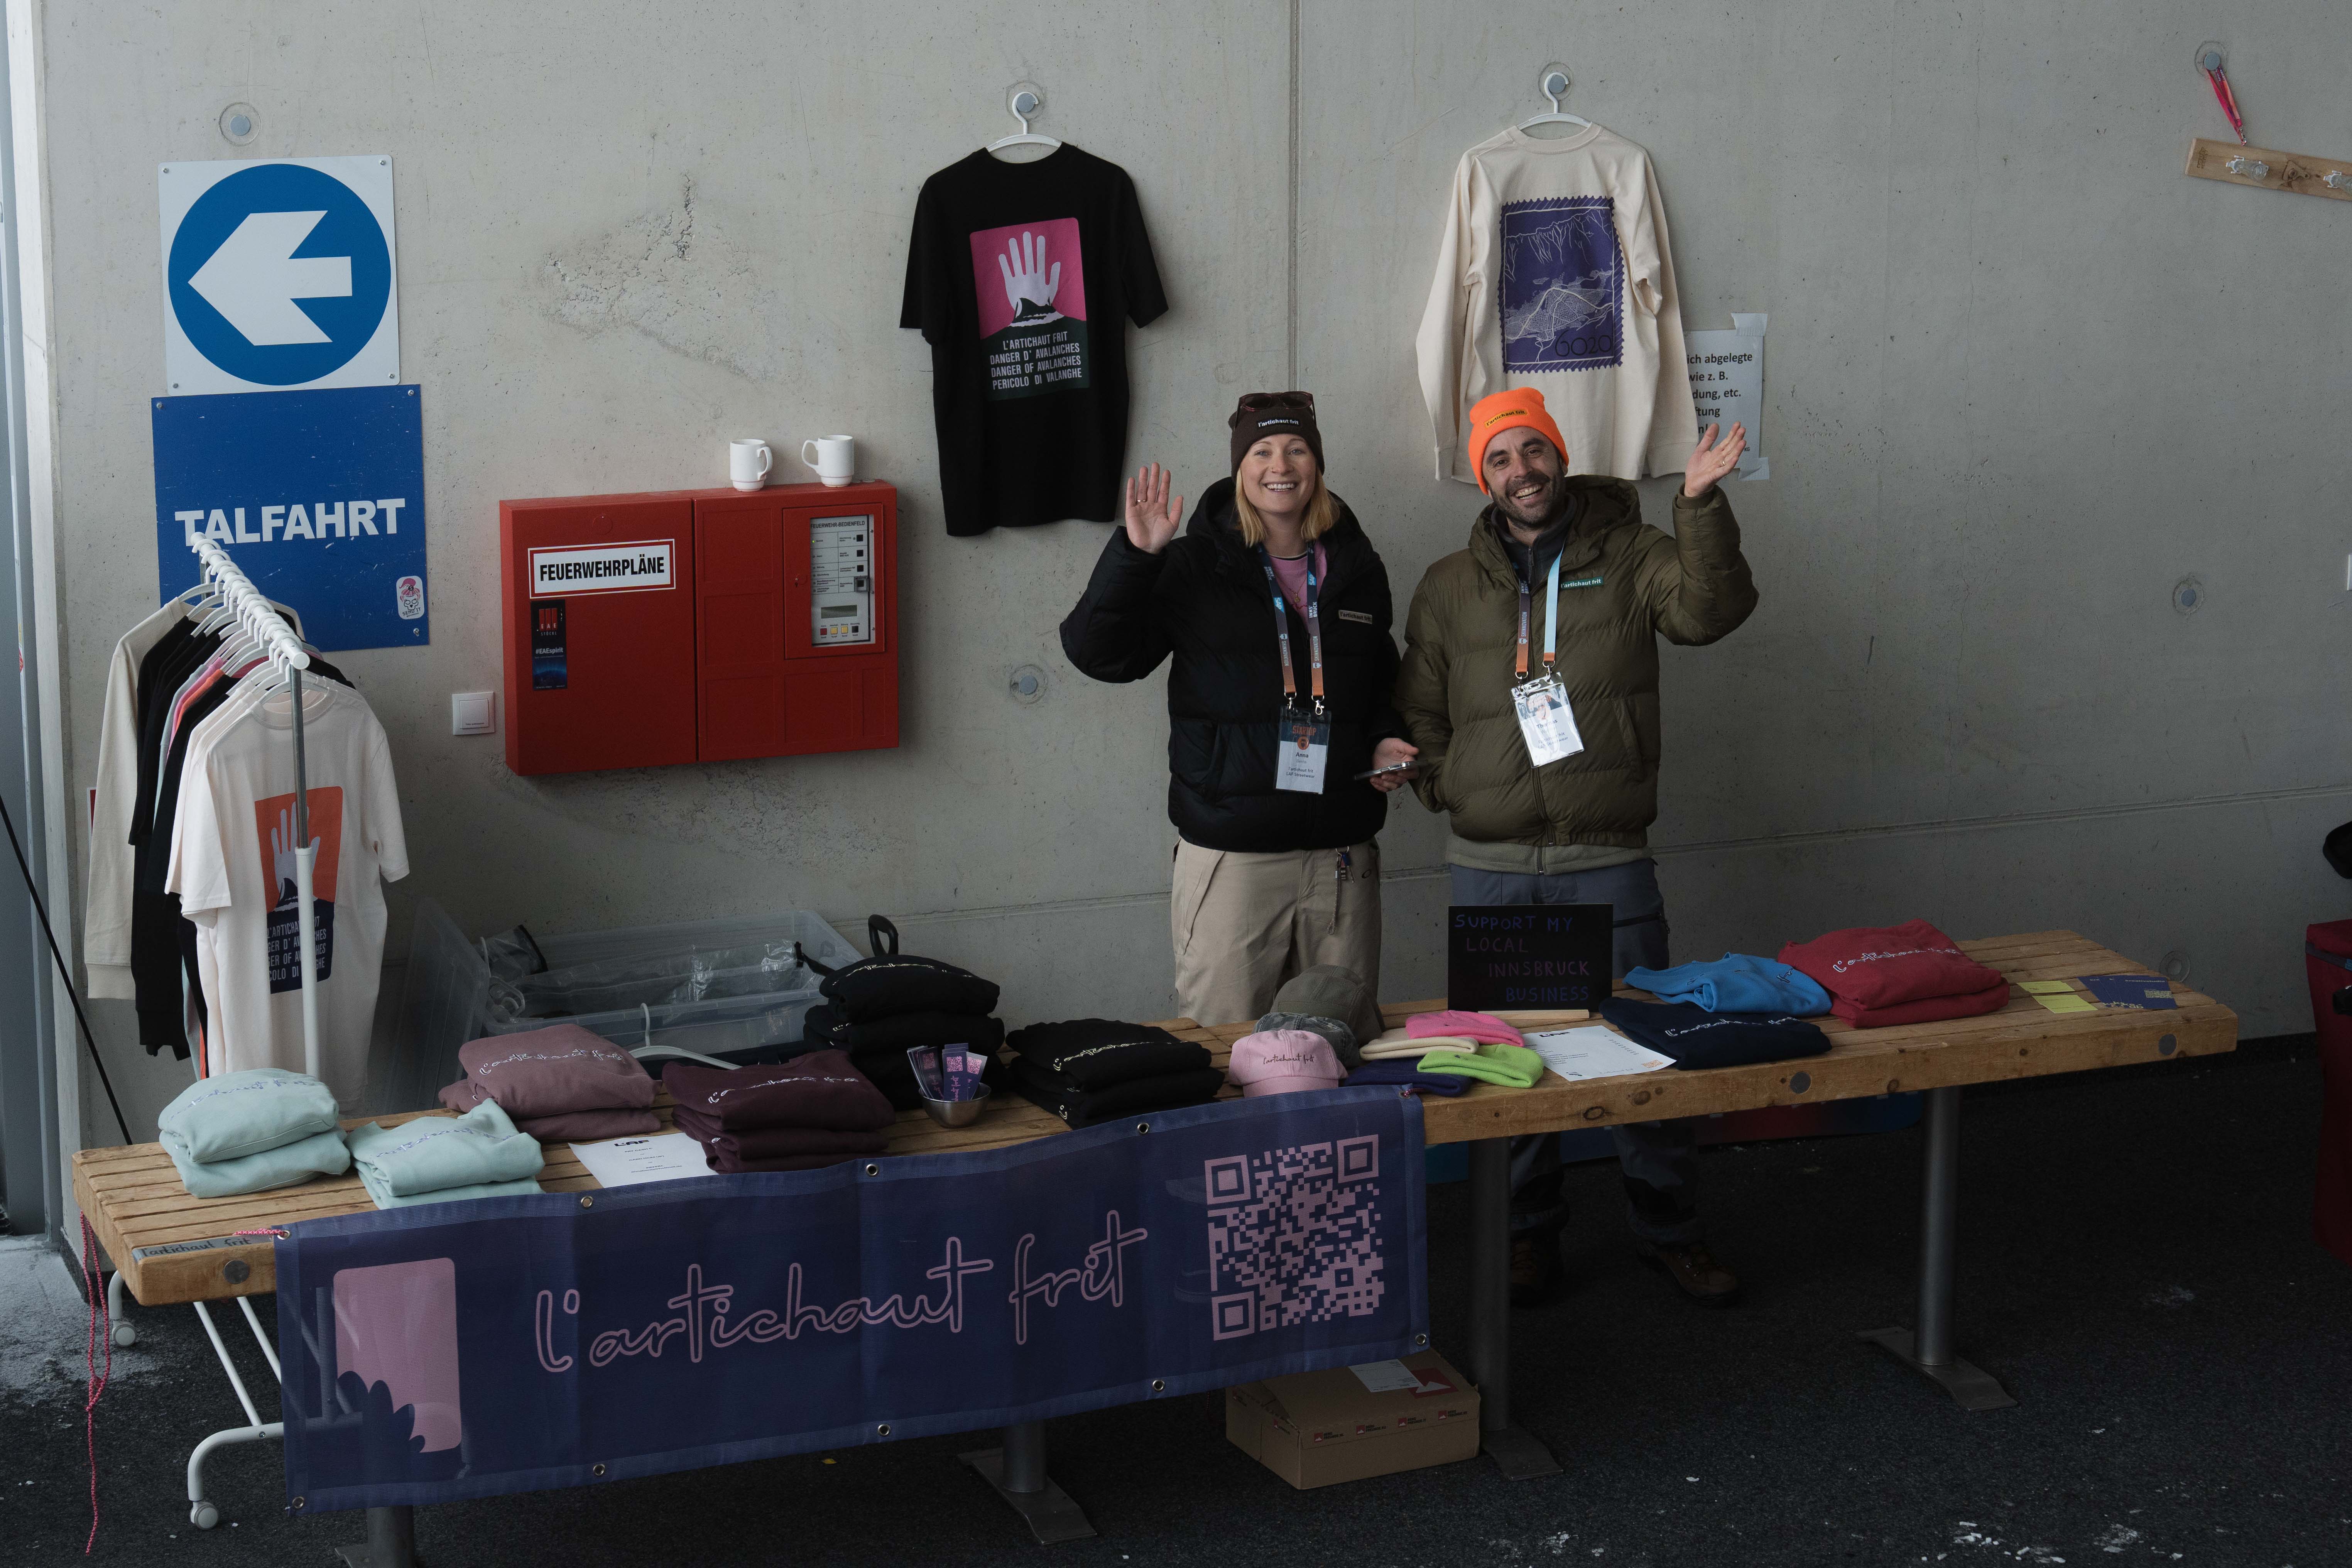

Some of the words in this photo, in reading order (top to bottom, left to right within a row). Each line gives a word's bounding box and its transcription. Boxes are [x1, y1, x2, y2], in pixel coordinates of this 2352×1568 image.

[1002, 334, 1051, 350] L'ARTICHAUT
[1052, 331, 1068, 343] FRIT
[1554, 330, 1613, 358] 6020
[990, 351, 1021, 365] DANGER
[1023, 350, 1032, 361] D'
[1035, 343, 1080, 359] AVALANCHES
[1687, 354, 1701, 364] ich
[1704, 352, 1753, 365] abgelegte
[991, 364, 1021, 377] DANGER
[1024, 362, 1034, 373] OF
[1037, 355, 1081, 372] AVALANCHES
[992, 375, 1029, 390] PERICOLO
[1034, 374, 1043, 385] DI
[1046, 368, 1082, 383] VALANGHE
[1719, 371, 1728, 380] B.
[1692, 389, 1721, 400] dung,
[1723, 388, 1741, 397] etc.
[1258, 419, 1289, 427] l'artichaut
[1487, 411, 1515, 426] l'artichaut
[175, 498, 406, 547] TALFAHRT
[811, 520, 865, 529] FEUERWEHR-BEDIENFELD
[539, 554, 665, 582] FEUERWEHRPLÄNE
[1561, 580, 1591, 588] l'artichaut
[1281, 640, 1289, 667] SKINNOVATION
[1292, 725, 1317, 736] STARTUP
[267, 921, 299, 939] L'ARTICHA
[1454, 914, 1536, 931] SUPPORT
[1547, 917, 1573, 932] MY
[267, 940, 280, 952] GER
[283, 938, 291, 950] D'
[1466, 937, 1529, 952] LOCAL
[283, 952, 292, 965] OF
[292, 965, 299, 978] DI
[1489, 960, 1590, 978] INNSBRUCK
[1505, 986, 1590, 1002] BUSINESS
[1262, 1050, 1301, 1066] l'artichaut
[1302, 1053, 1315, 1065] frit
[141, 1241, 215, 1257] l'artichaut
[223, 1237, 251, 1247] frit
[535, 1237, 994, 1374] l'artichaut
[1009, 1209, 1148, 1346] frit
